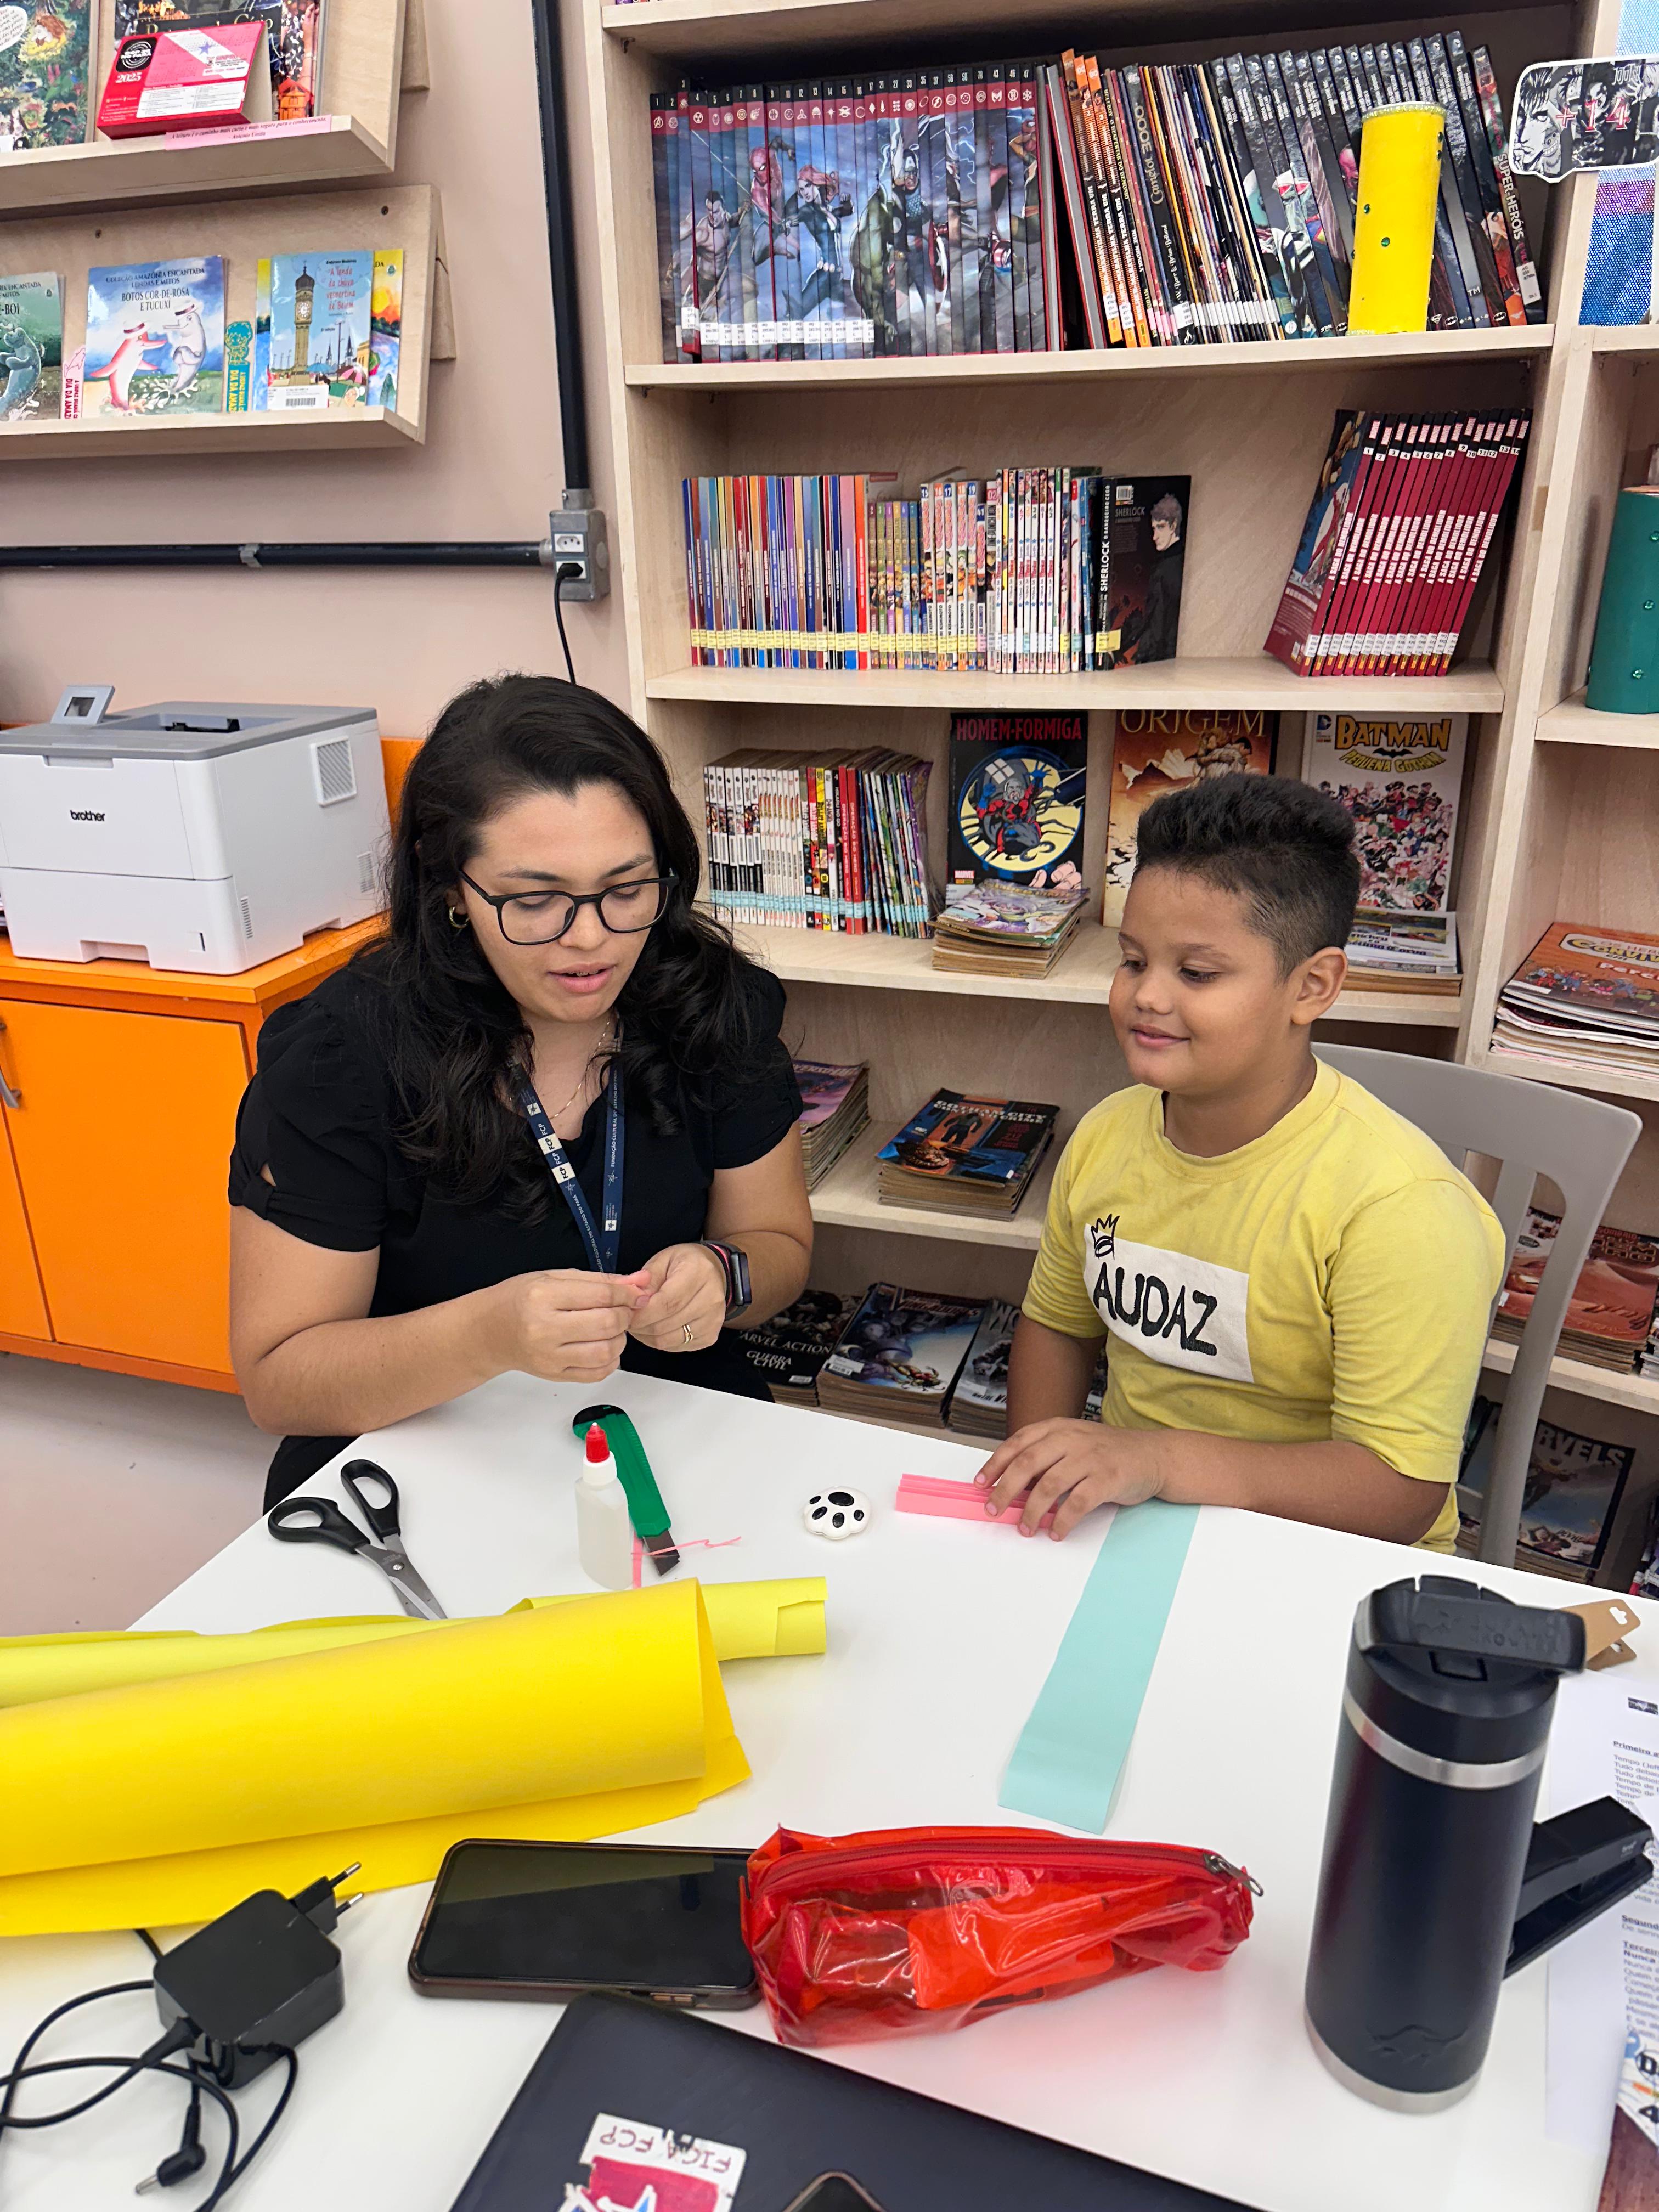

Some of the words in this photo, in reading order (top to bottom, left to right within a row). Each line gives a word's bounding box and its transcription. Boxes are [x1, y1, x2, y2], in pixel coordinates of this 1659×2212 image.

[116, 72, 142, 83] 2025
[1556, 97, 1631, 132] +14
[1133, 105, 1152, 153] 3000
[1144, 155, 1165, 205] Camelot
[1497, 152, 1525, 241] SUPER-HERÓIS
[167, 268, 205, 277] ENCANTADA
[122, 291, 144, 301] BOTOS
[145, 287, 189, 299] COR-DE-ROSA
[140, 303, 145, 311] E
[145, 298, 171, 310] TUCUXÍ
[988, 489, 997, 499] 02
[1115, 506, 1146, 517] SHERLOCK
[1100, 541, 1110, 592] SHERLOCK
[956, 718, 1082, 741] HOMEM-FORMIGA
[1120, 709, 1265, 737] ORIGEM
[1334, 715, 1452, 752] BATMAN
[1339, 749, 1391, 772] PEQUENA
[1394, 751, 1447, 773] GOTHAM
[70, 809, 105, 822] brother
[538, 1123, 549, 1135] FCP
[545, 1138, 555, 1150] FCP
[553, 1152, 562, 1165] FCP
[558, 1166, 569, 1180] FCP
[1093, 1262, 1217, 1356] AUDAZ
[740, 1330, 778, 1348] ARVEL
[782, 1340, 833, 1355] ACTION
[746, 1350, 792, 1365] GUERRA
[753, 1358, 787, 1370] CIVIL
[1539, 1426, 1626, 1467] RVELS
[1613, 1740, 1650, 1756] Primeiro
[1613, 1754, 1640, 1766] Tempo
[1615, 1775, 1641, 1786] Tempo
[1623, 1950, 1655, 1963] Nunca
[600, 2126, 654, 2153] FCP
